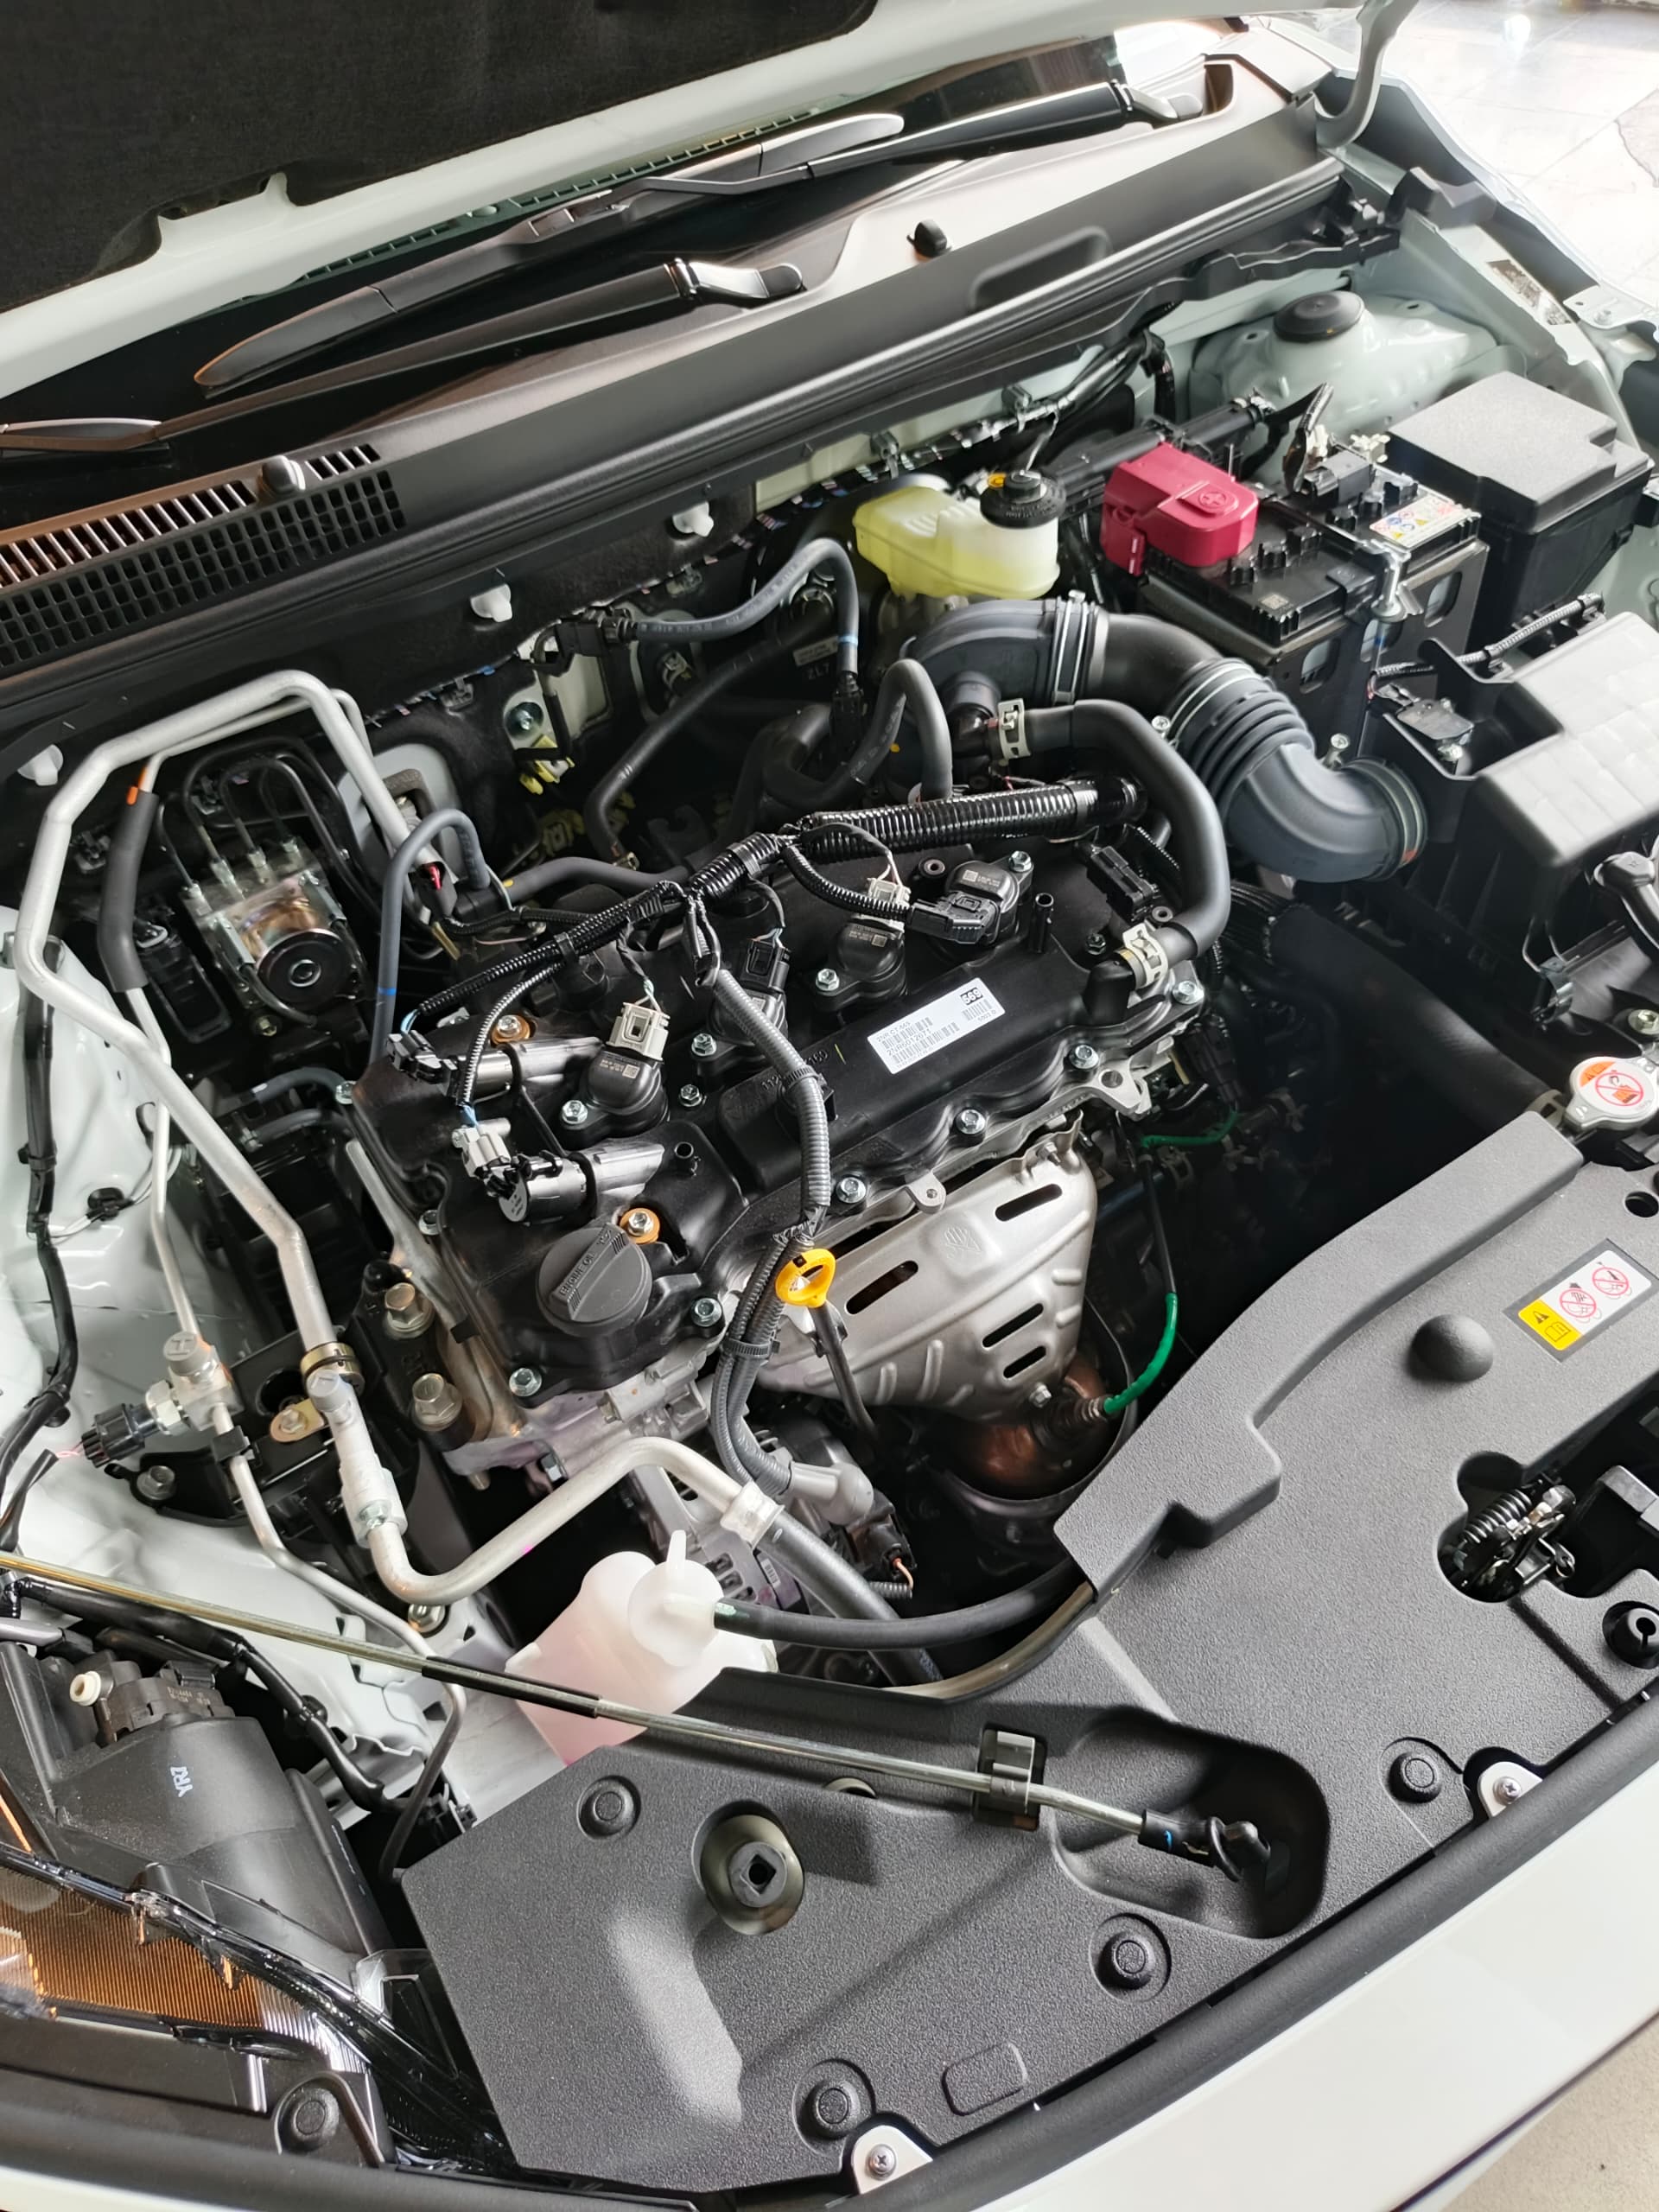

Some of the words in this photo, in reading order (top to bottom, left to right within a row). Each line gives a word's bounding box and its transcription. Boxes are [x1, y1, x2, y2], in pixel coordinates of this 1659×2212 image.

[961, 988, 983, 1004] 569
[558, 1264, 584, 1296] ENGINE
[582, 1251, 596, 1267] OIL
